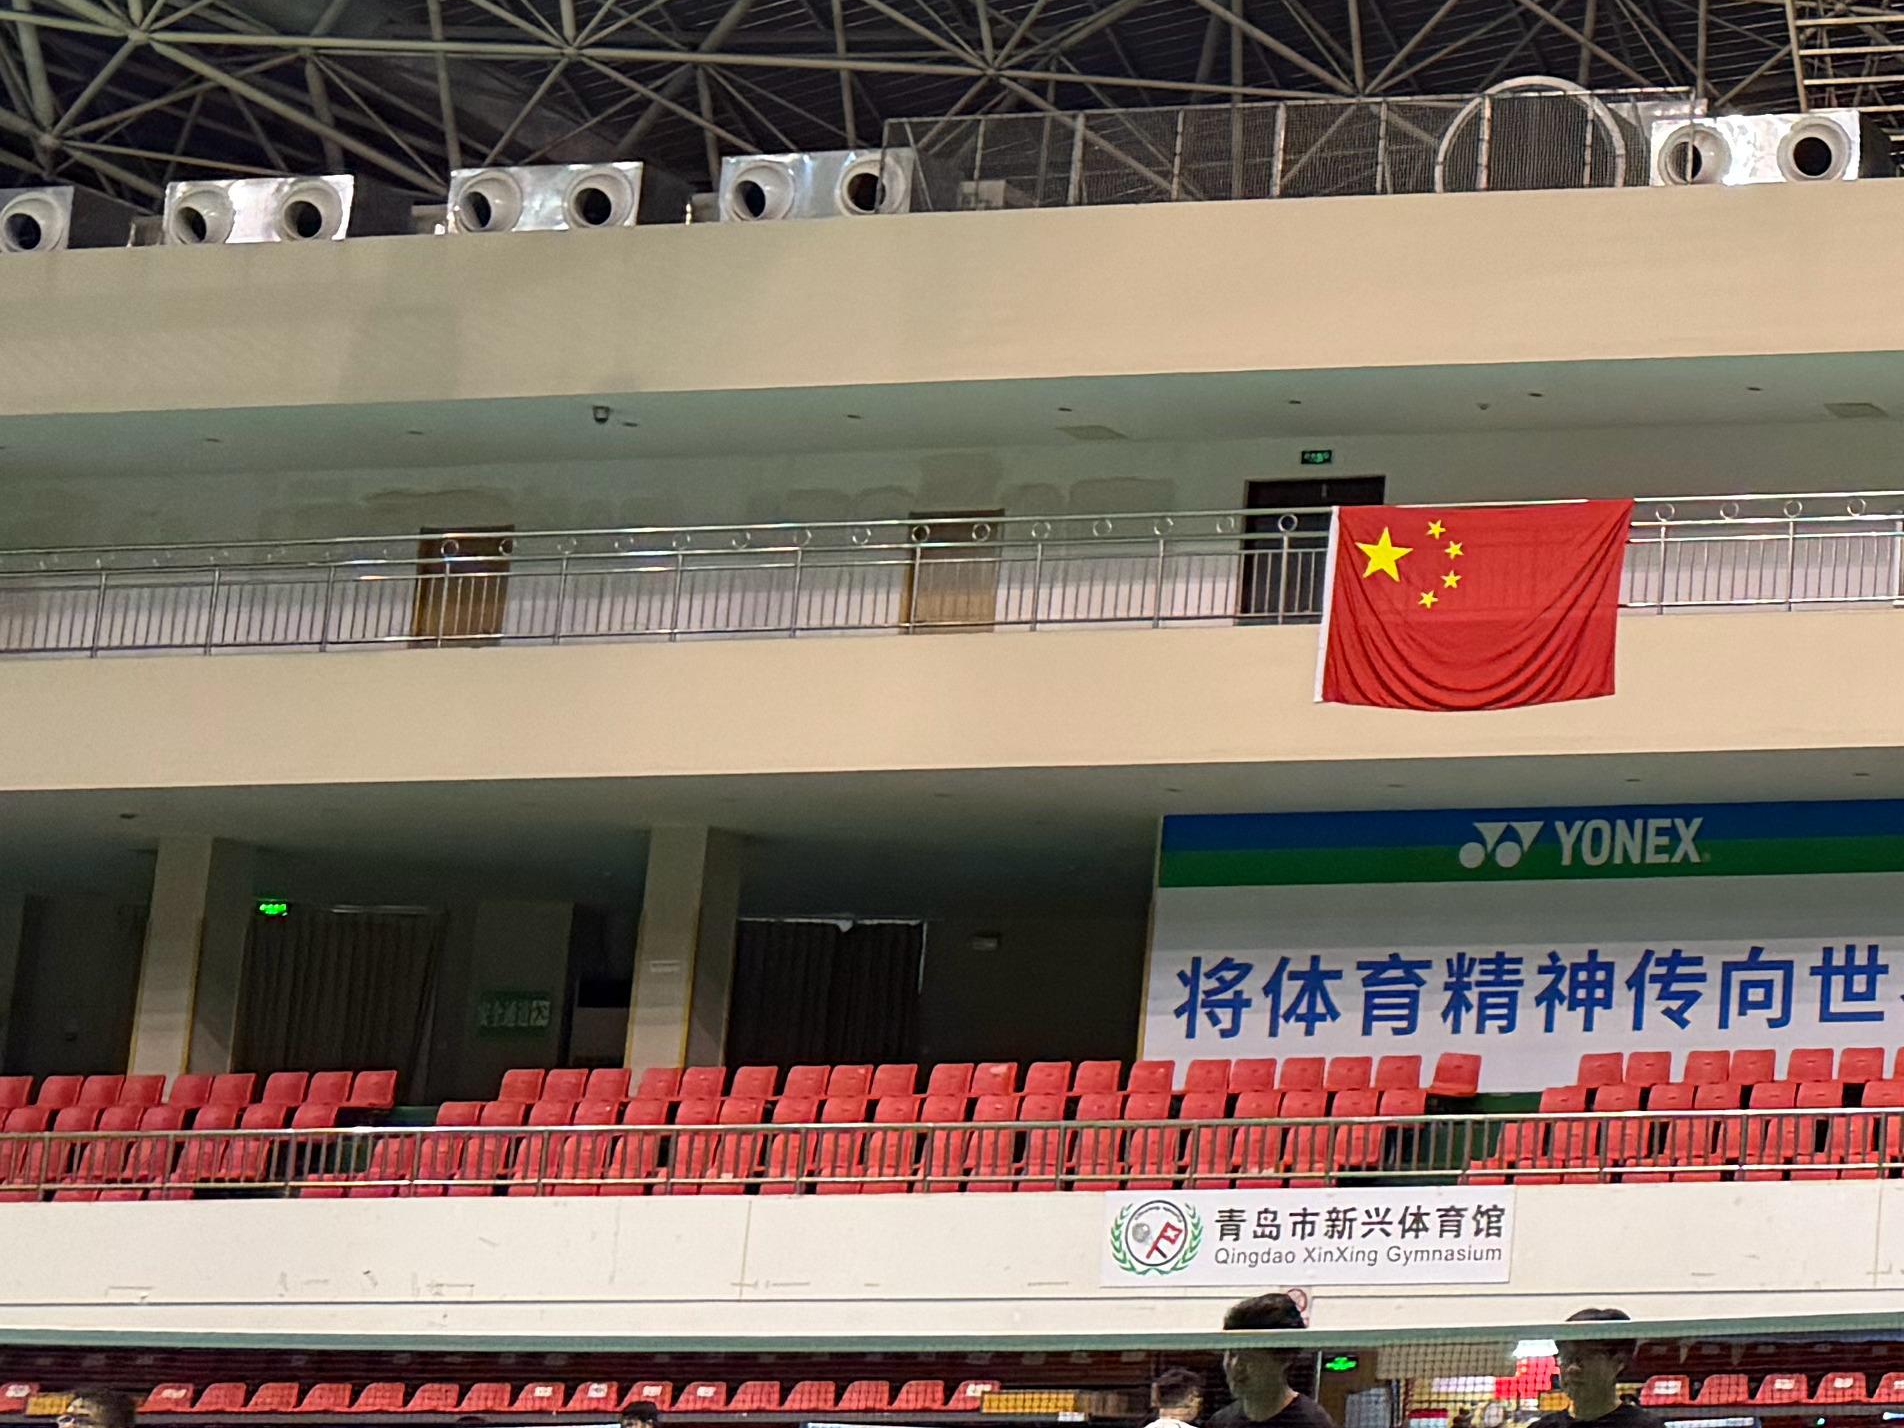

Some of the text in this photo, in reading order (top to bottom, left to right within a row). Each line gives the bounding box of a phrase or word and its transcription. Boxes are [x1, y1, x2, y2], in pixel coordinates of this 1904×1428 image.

[1554, 817, 1704, 866] YONEX
[1214, 1203, 1506, 1243] 青岛市新兴体育馆
[1214, 1244, 1502, 1268] Qingdao XinXing Gymnasium
